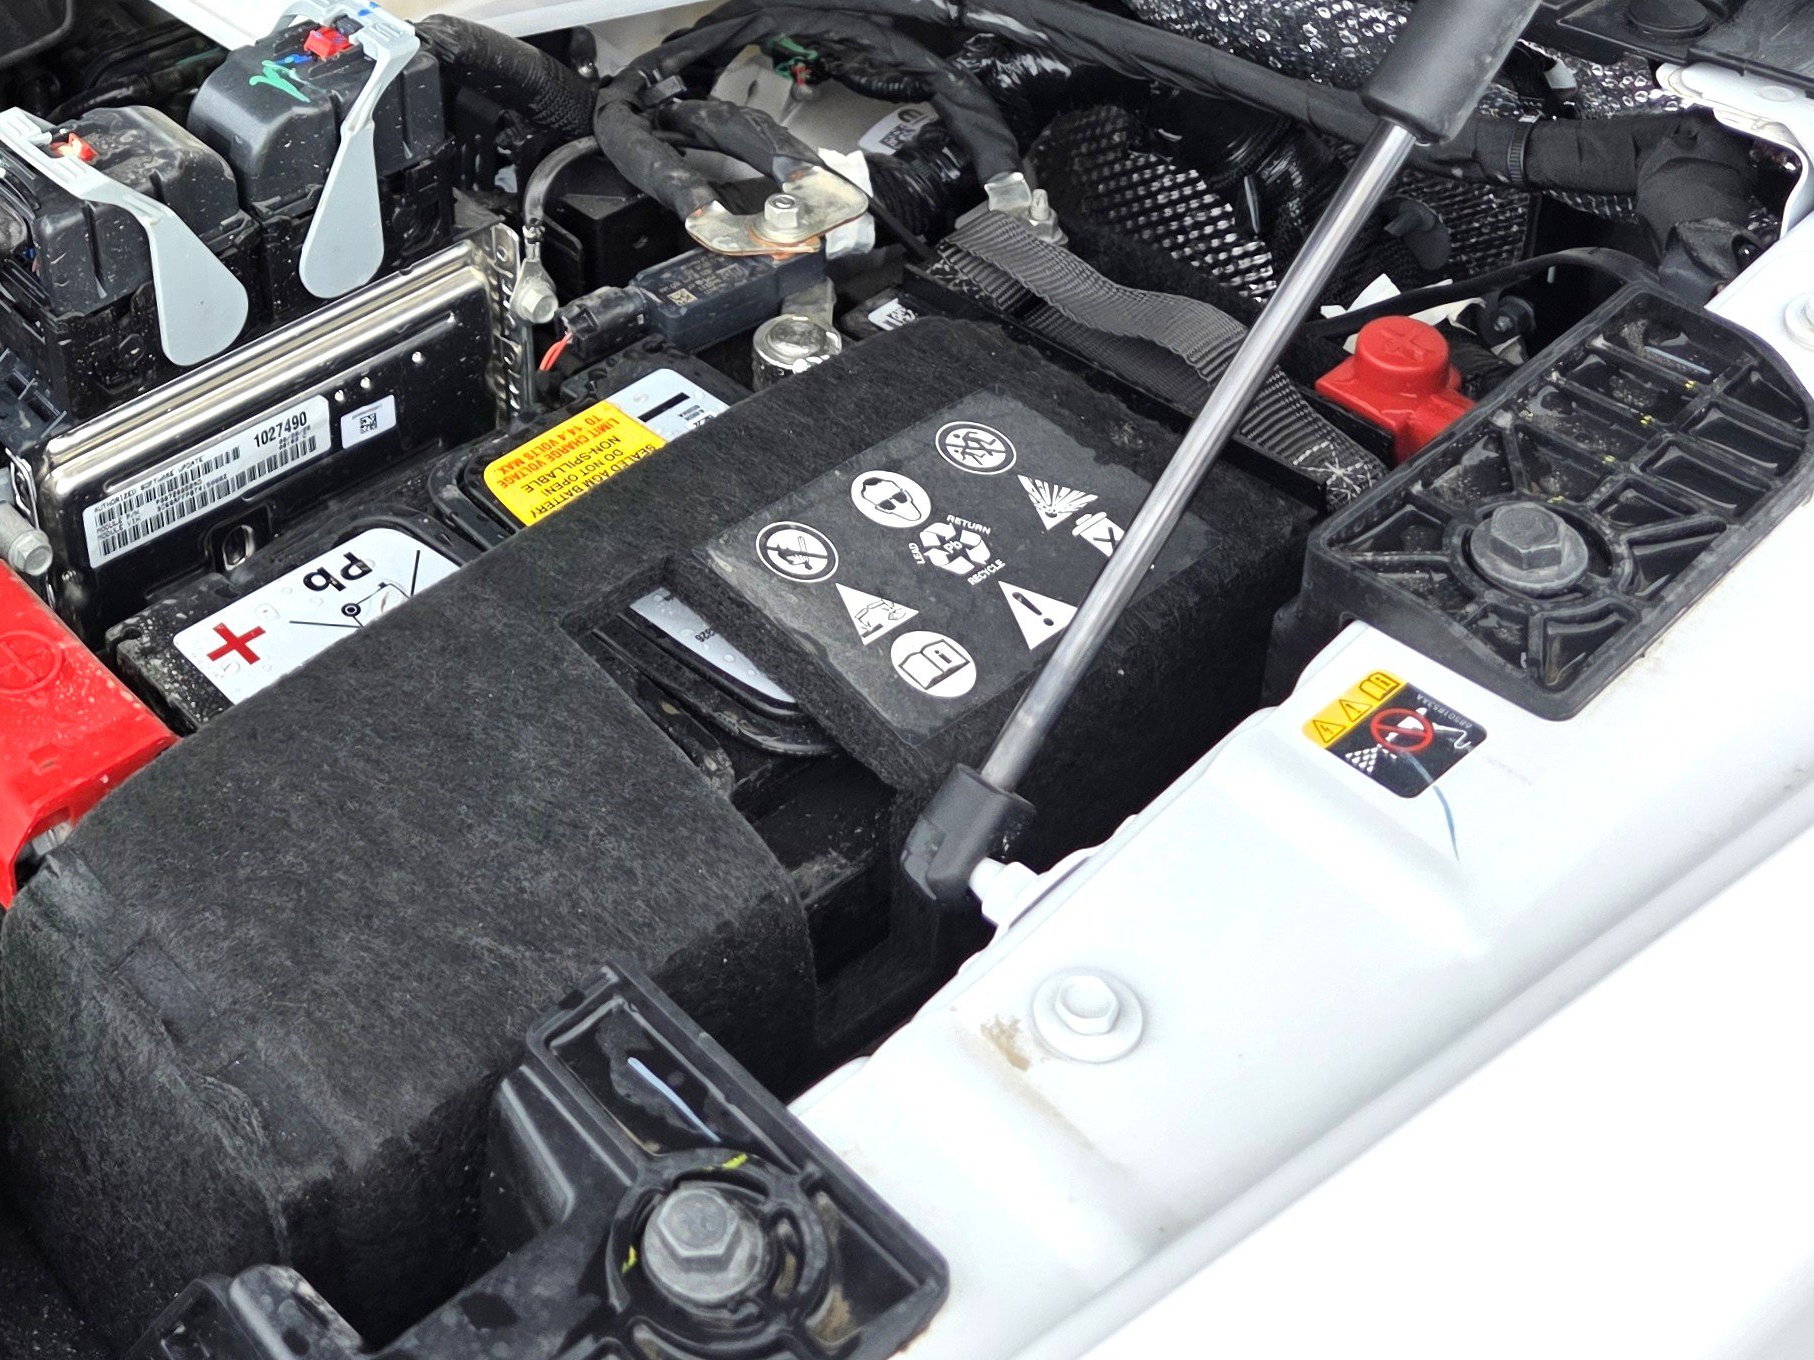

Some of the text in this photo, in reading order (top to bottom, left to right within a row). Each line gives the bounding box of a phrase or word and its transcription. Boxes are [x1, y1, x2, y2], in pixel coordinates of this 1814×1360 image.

[253, 410, 307, 449] 1027490
[583, 413, 602, 426] TO
[556, 423, 583, 441] 14.4
[495, 416, 620, 489] LIMIT CHARGE VOLTAGE
[522, 438, 558, 460] VOLTS
[603, 448, 623, 462] DO
[520, 433, 621, 494] NON-SPILLABLE
[578, 458, 604, 475] NOT
[529, 483, 584, 517] BATTERY
[946, 514, 990, 534] RETURN
[908, 542, 925, 564] LEAD
[302, 551, 372, 592] Pb
[966, 558, 1005, 585] RECYCLE
